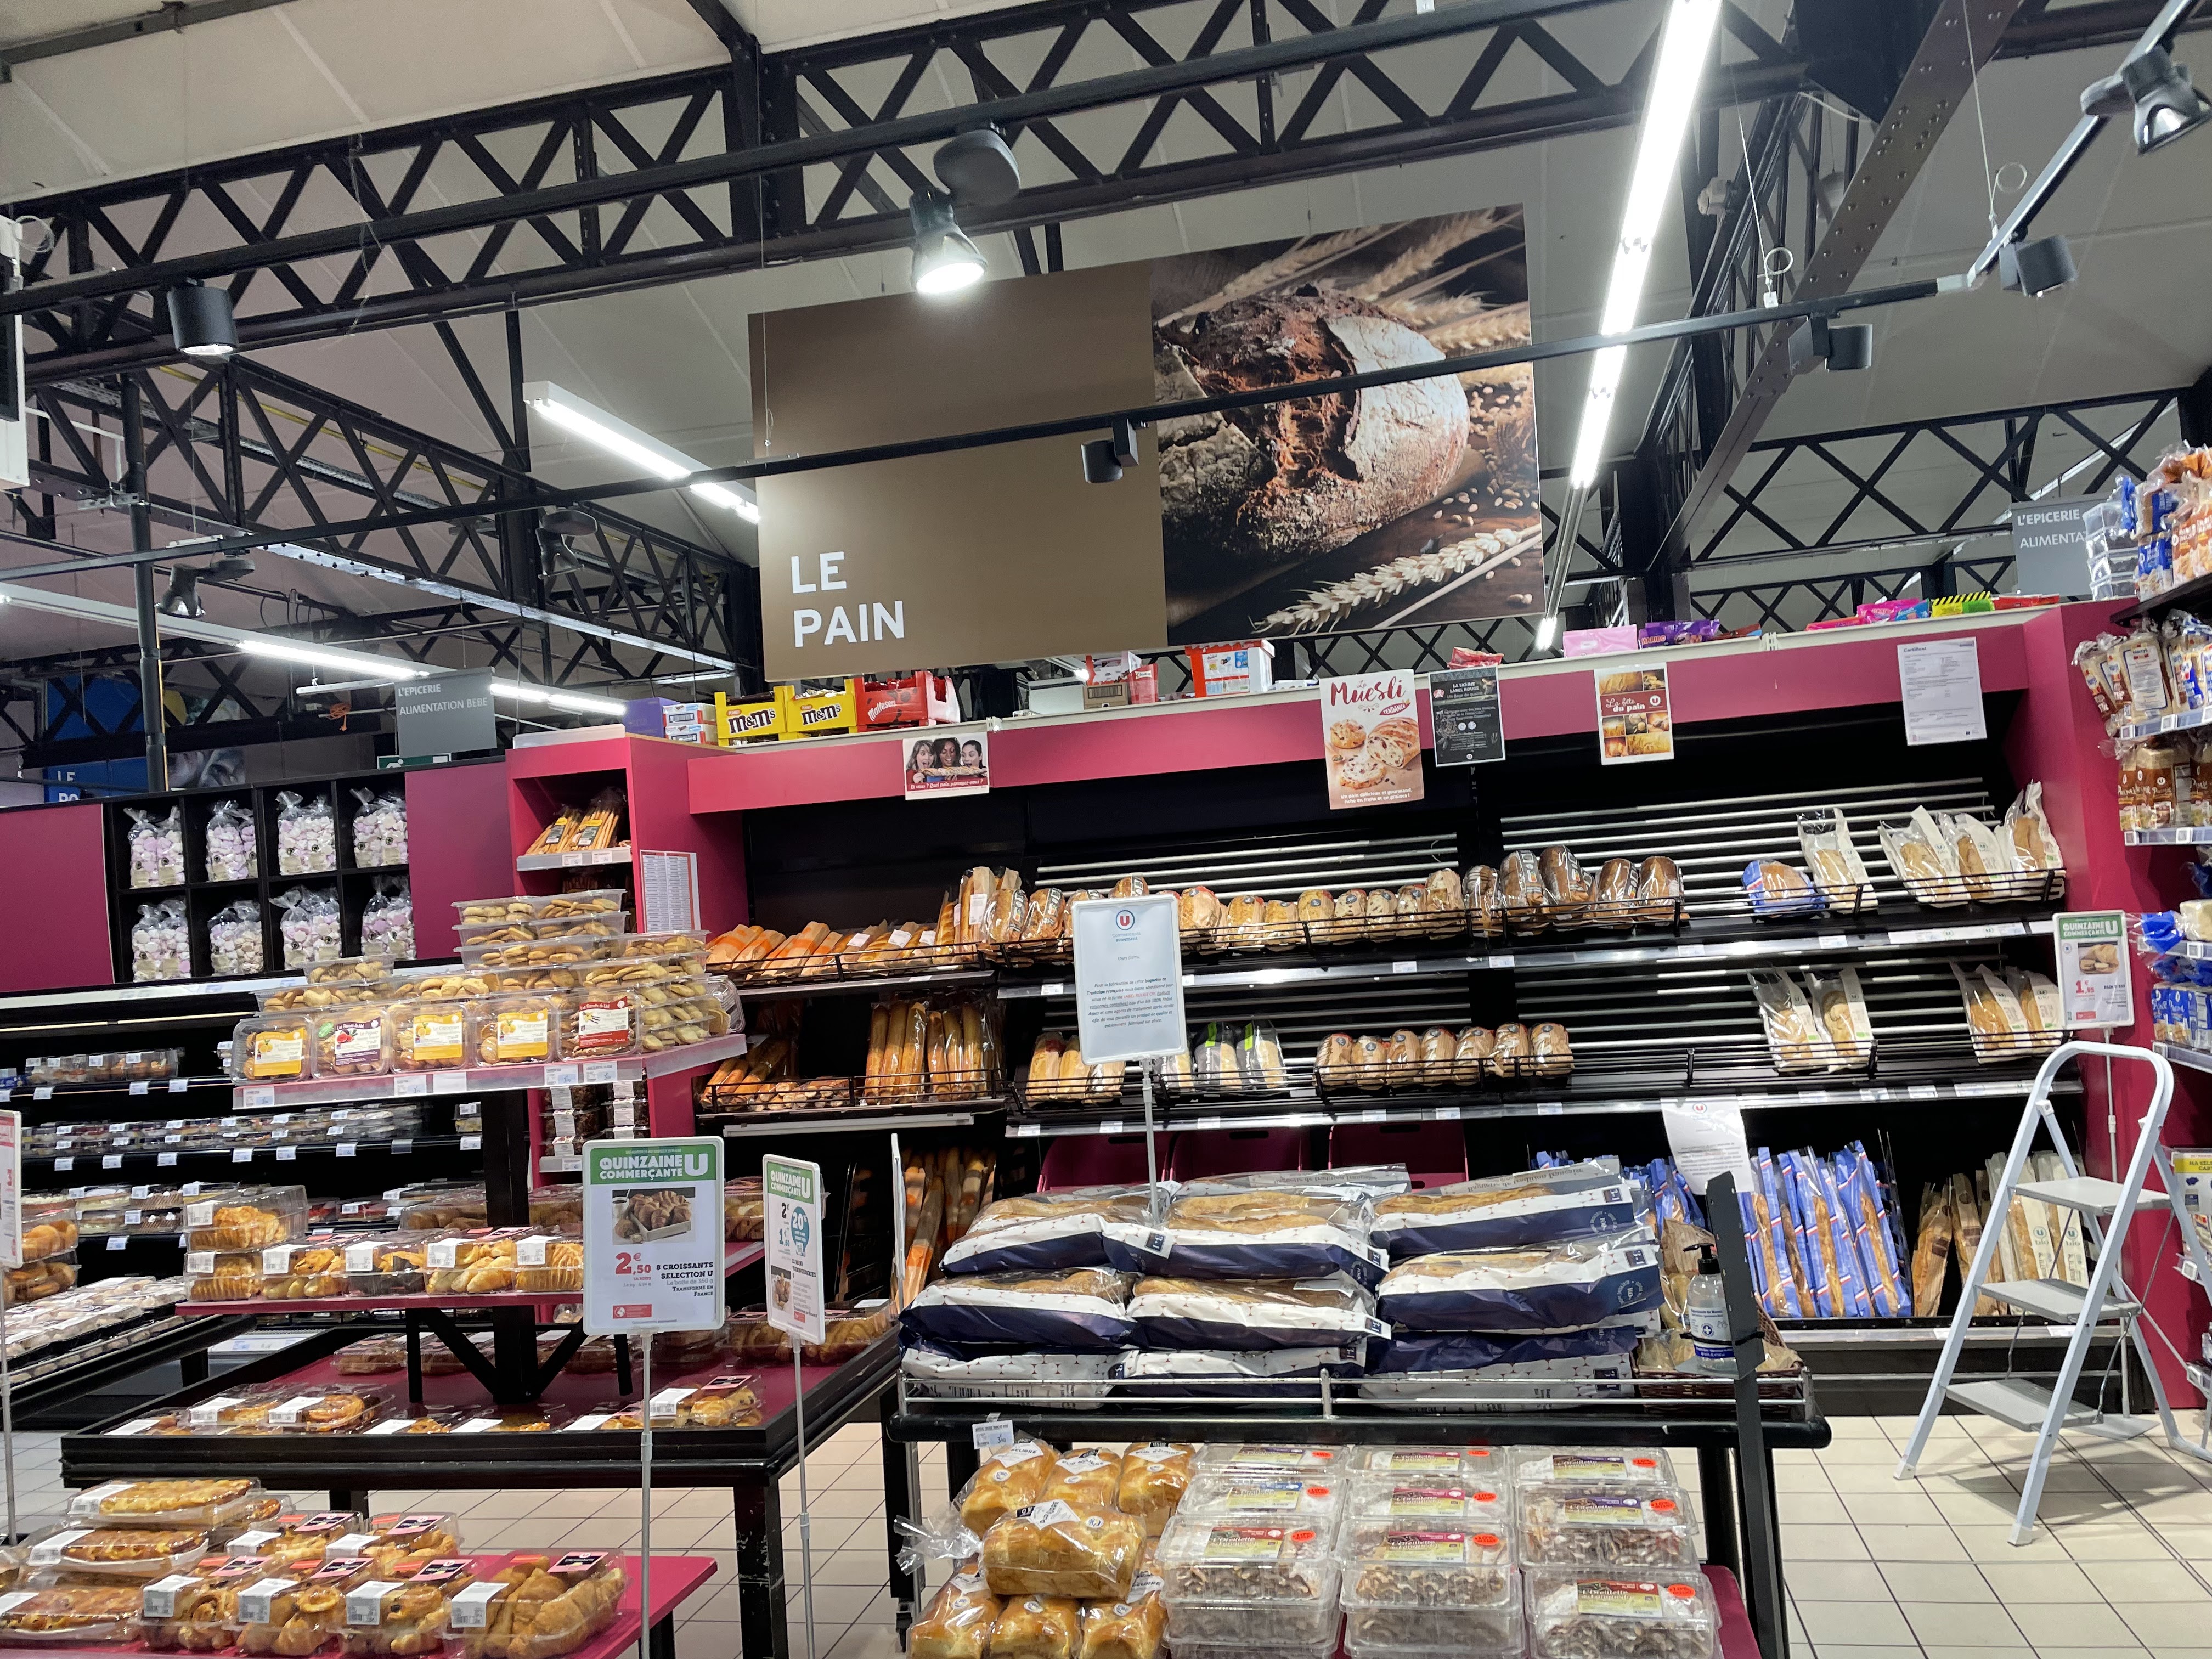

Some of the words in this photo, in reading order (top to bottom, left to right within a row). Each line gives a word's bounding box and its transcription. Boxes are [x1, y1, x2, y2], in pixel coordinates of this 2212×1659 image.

[2017, 509, 2080, 526] L'EPICERIE
[791, 551, 847, 594] LE
[793, 601, 905, 648] PAIN
[1641, 635, 1666, 645] HARIBO
[398, 684, 441, 697] L'EPICERIE
[1331, 676, 1406, 706] Muesli
[399, 700, 464, 715] ALIMENTATION
[467, 697, 488, 708] BEBE
[868, 700, 896, 721] Maltesers
[1627, 703, 1645, 712] pain
[1120, 916, 1130, 926] U
[2106, 921, 2118, 934] U
[599, 1154, 682, 1170] QUINZAINE
[685, 1153, 708, 1176] U
[599, 1168, 682, 1180] COMMERÇANTE
[771, 1170, 802, 1188] QUINZAINE
[802, 1178, 811, 1199] U
[663, 1262, 713, 1271] CROISSANTS
